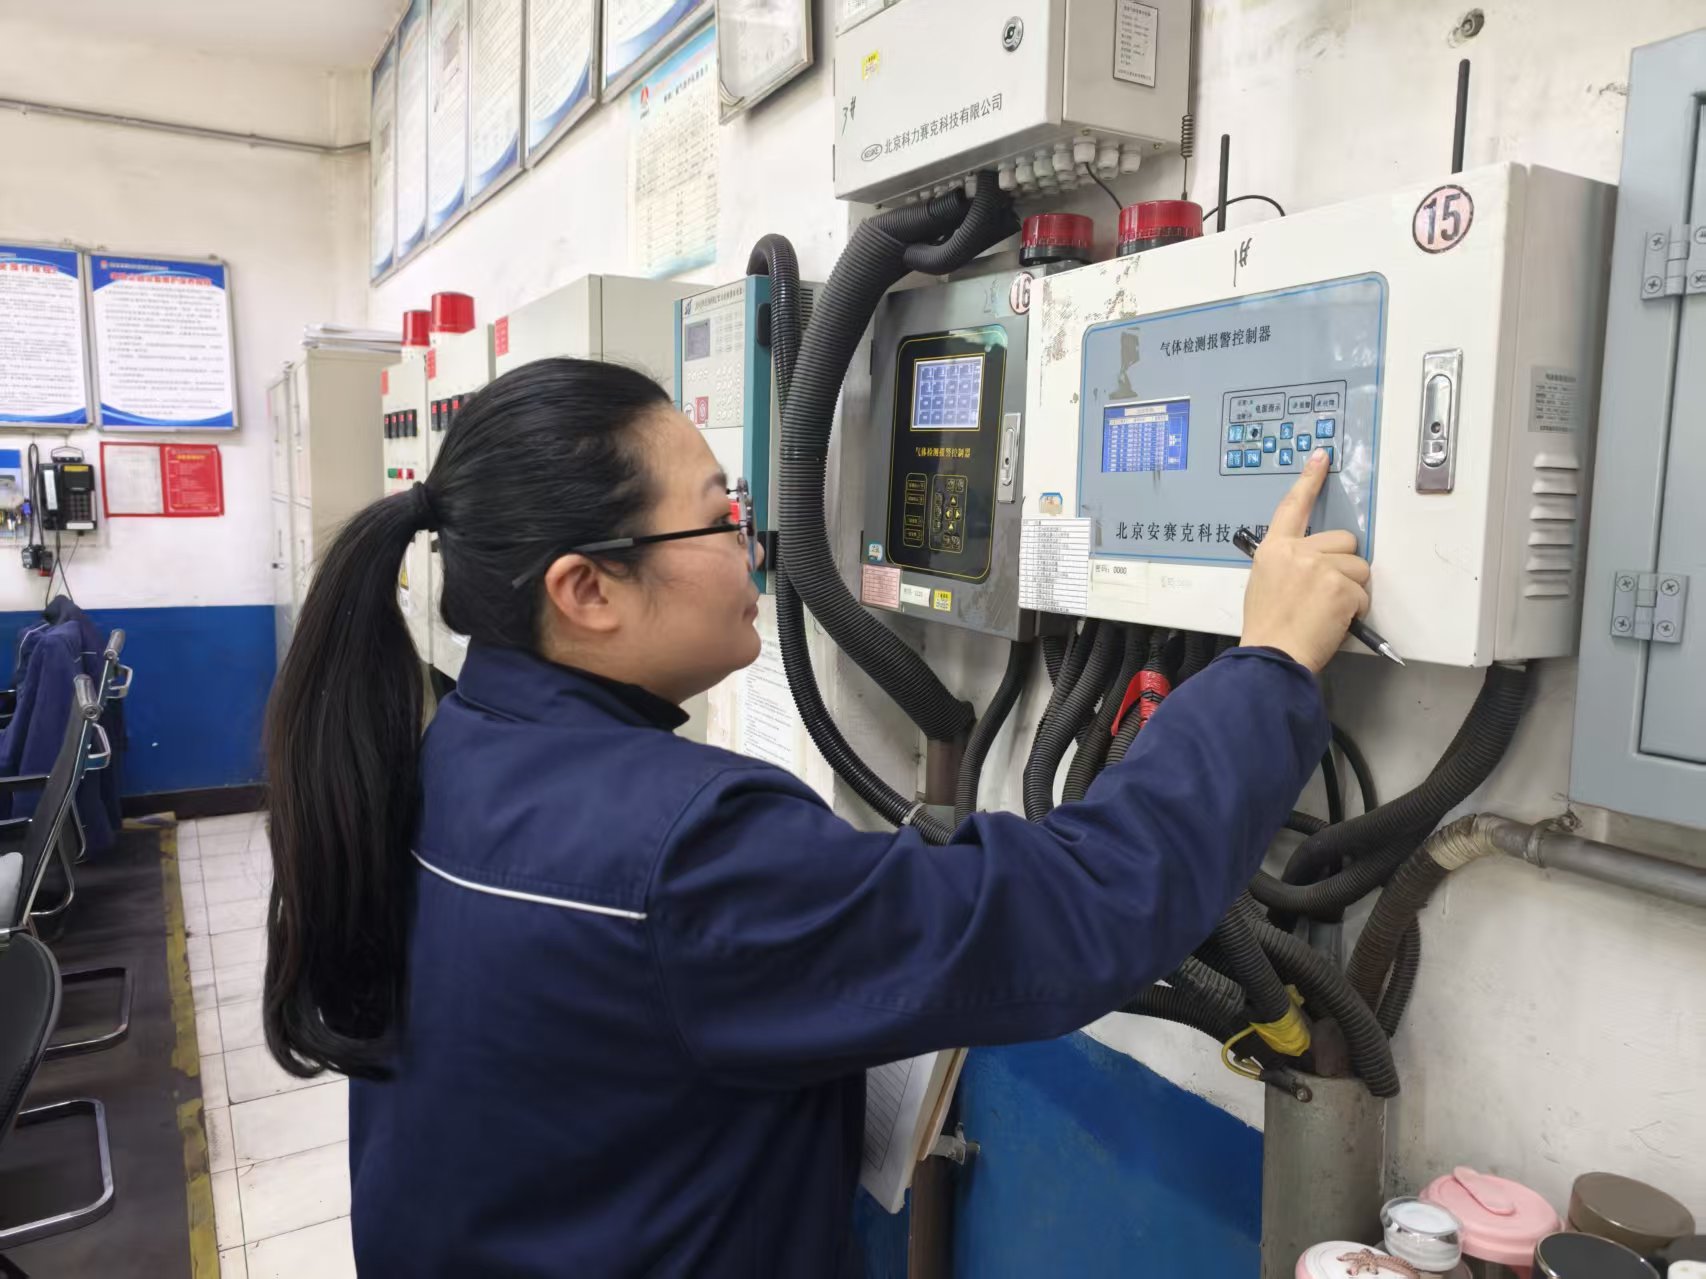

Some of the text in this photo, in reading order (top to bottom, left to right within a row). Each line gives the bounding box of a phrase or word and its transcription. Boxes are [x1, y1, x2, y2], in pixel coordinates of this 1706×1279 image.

[884, 92, 1003, 154] 北京科力赛克科技有限公司
[1423, 193, 1461, 245] 15
[1014, 276, 1031, 309] 16
[1160, 325, 1271, 357] 气体检测报警控制器
